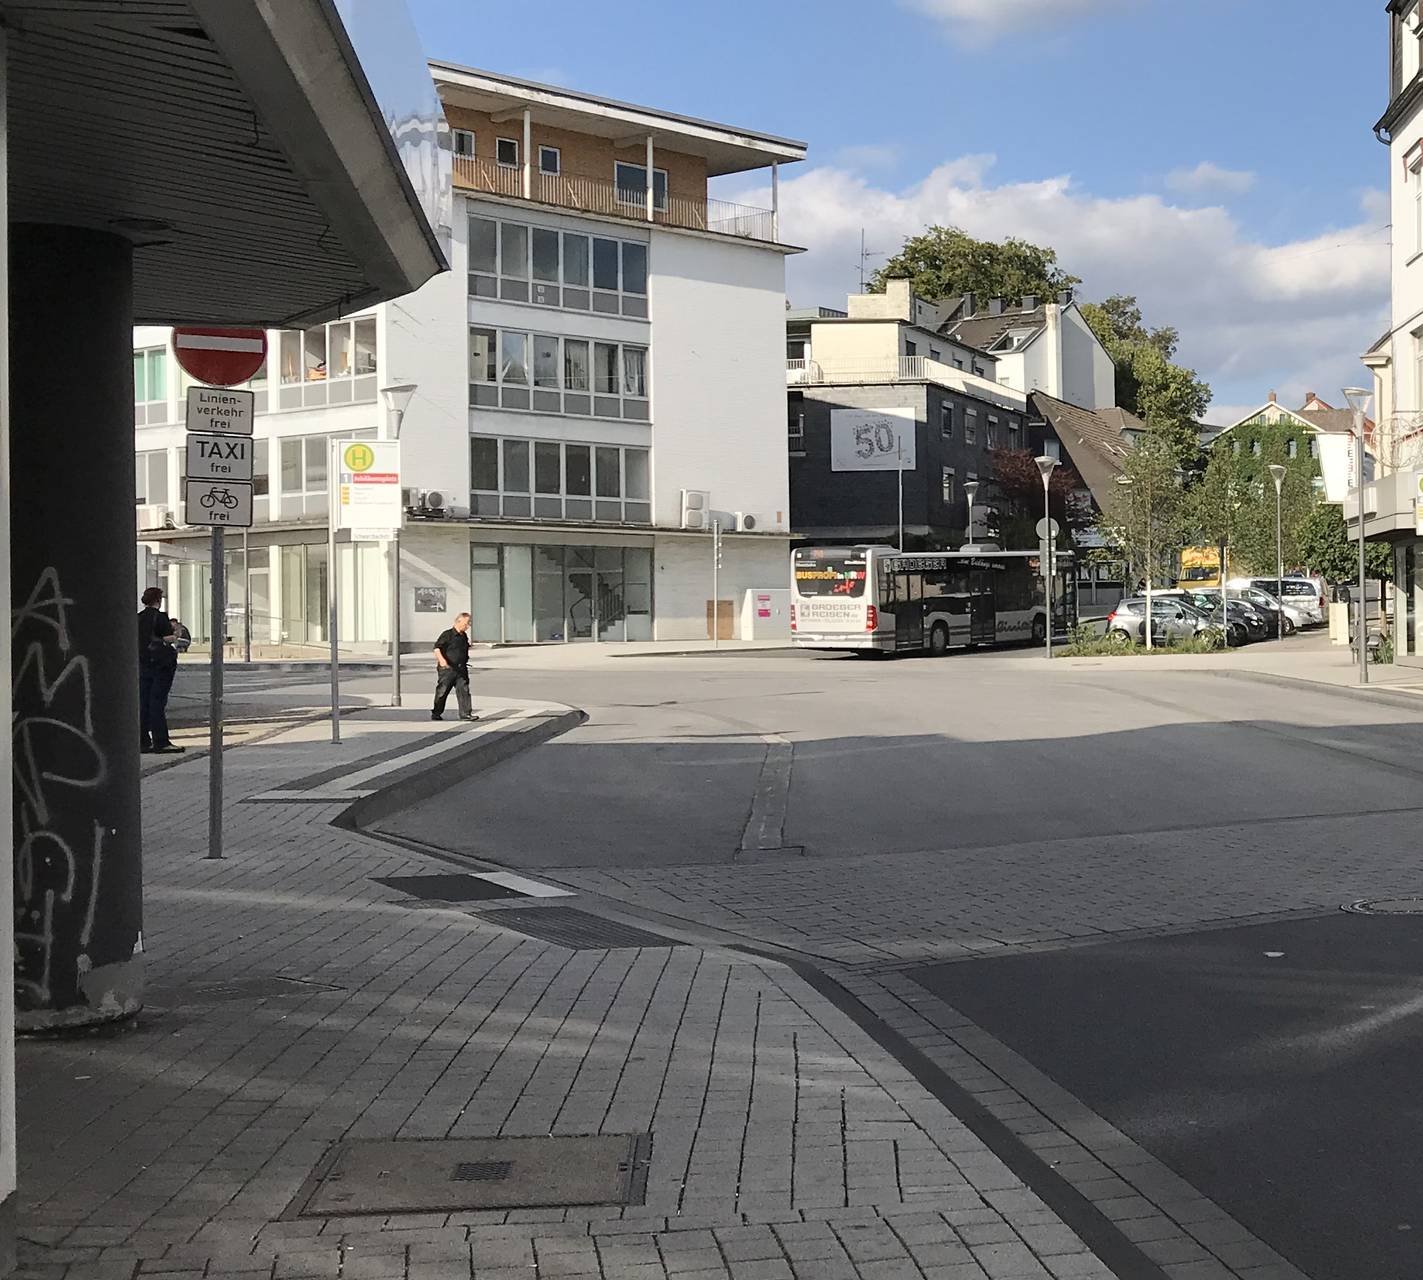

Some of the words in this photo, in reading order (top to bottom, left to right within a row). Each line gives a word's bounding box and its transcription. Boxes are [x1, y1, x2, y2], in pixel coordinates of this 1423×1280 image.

[200, 392, 242, 405] Linien-
[197, 405, 245, 418] verkehr
[210, 417, 231, 429] frei
[854, 419, 895, 459] 50
[196, 441, 245, 460] TAXI
[210, 462, 231, 473] frei
[209, 511, 230, 521] frei
